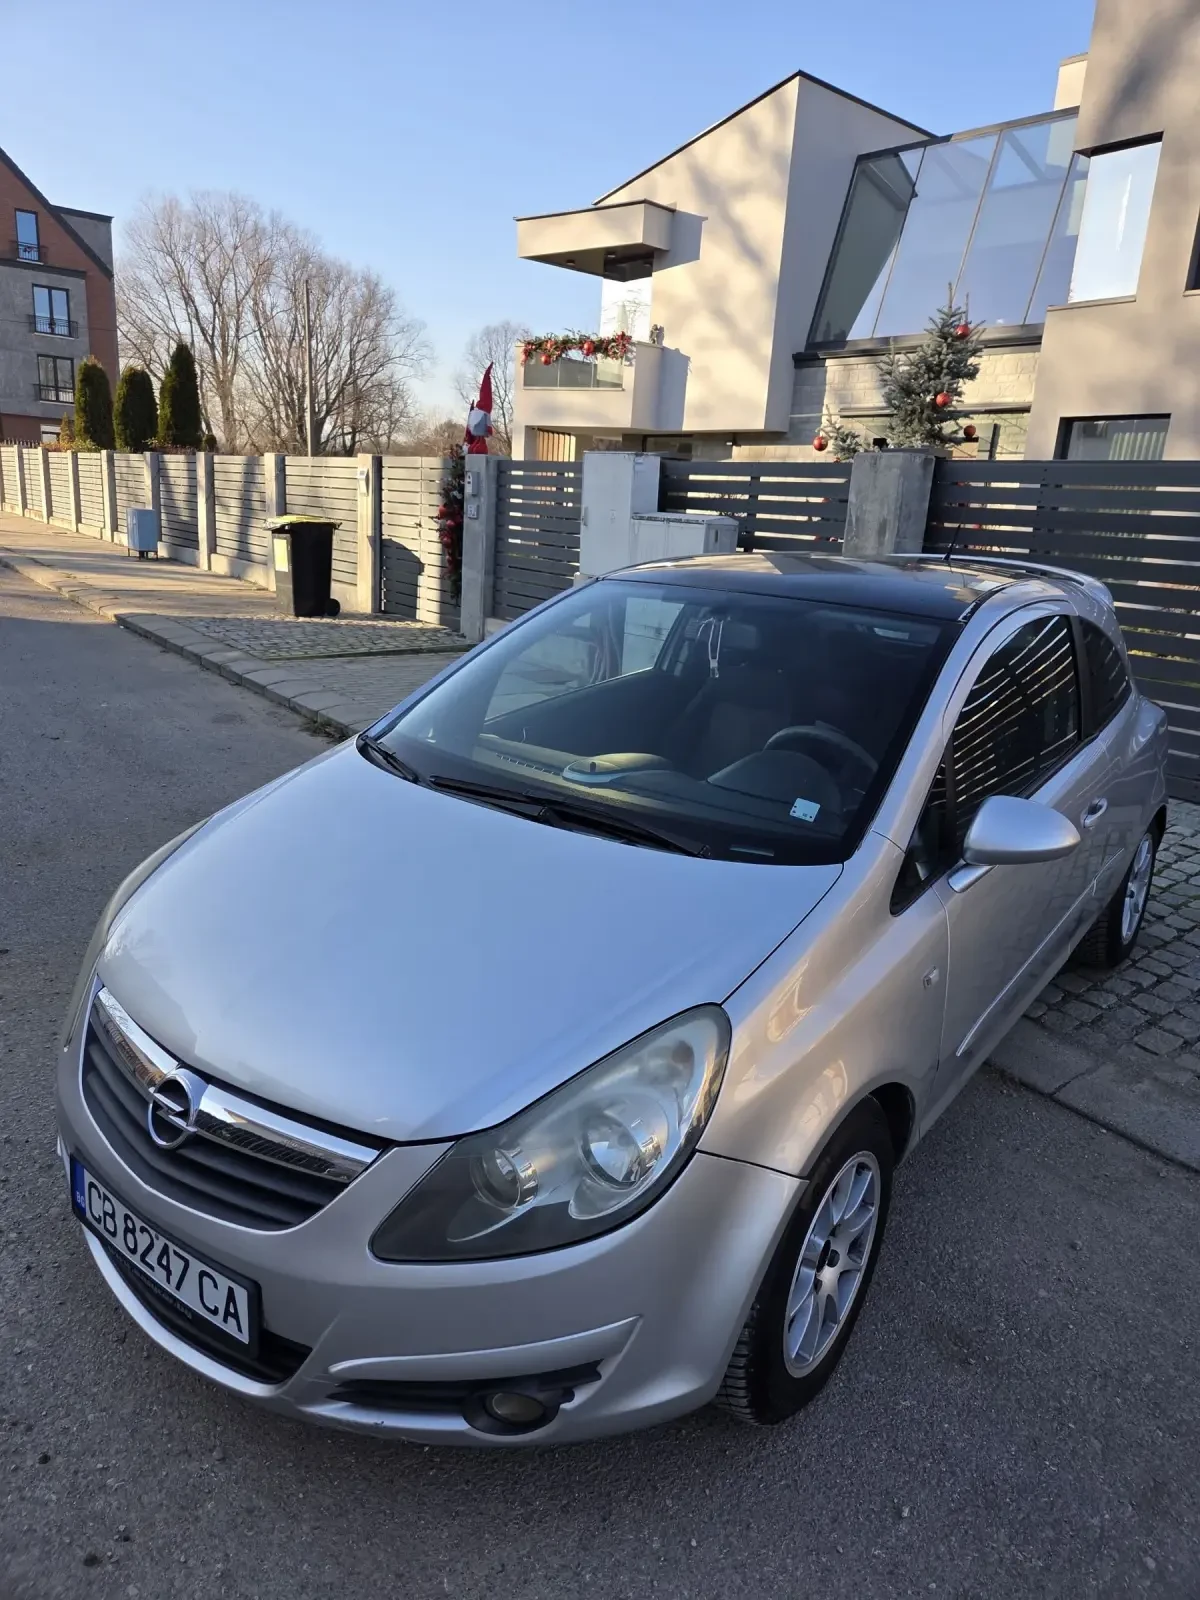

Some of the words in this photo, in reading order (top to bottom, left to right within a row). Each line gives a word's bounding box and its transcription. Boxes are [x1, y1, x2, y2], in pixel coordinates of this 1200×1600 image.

[76, 1190, 86, 1209] BG
[88, 1181, 117, 1238] CB
[123, 1213, 190, 1292] 8247
[198, 1269, 243, 1334] CA
